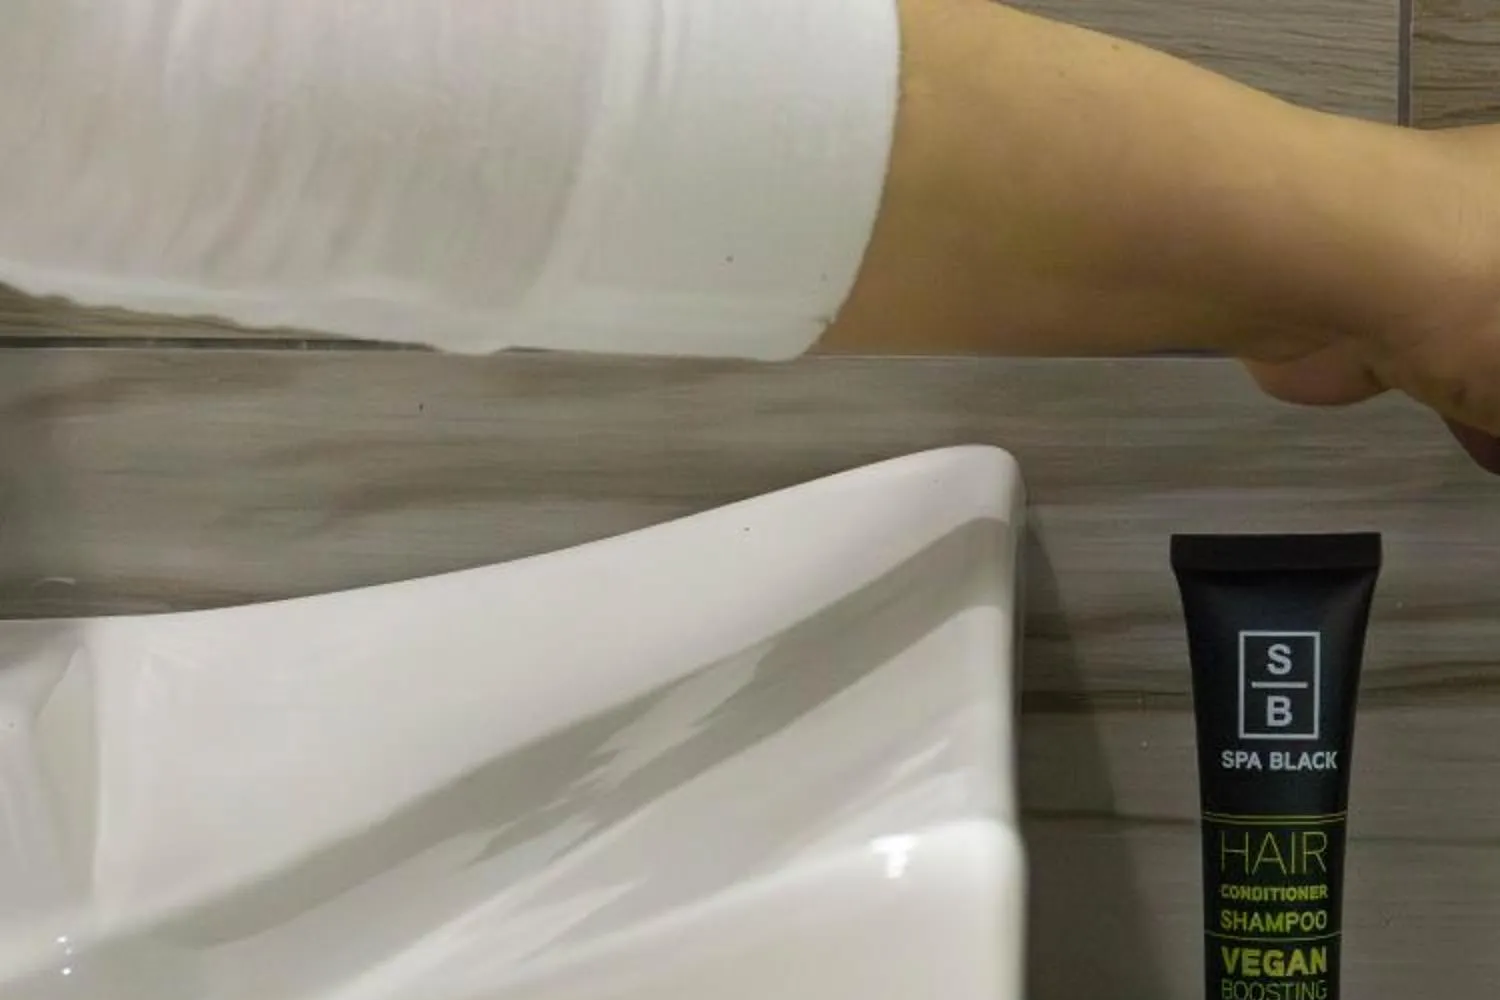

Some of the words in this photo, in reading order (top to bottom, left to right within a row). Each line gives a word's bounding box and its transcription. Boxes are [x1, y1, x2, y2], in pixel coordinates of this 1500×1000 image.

[1267, 643, 1293, 675] S
[1266, 695, 1292, 727] B
[1221, 750, 1262, 770] SPA
[1269, 752, 1338, 770] BLACK
[1220, 831, 1328, 875] HAIR
[1219, 884, 1328, 901] CONDITIONER
[1220, 909, 1328, 933] SHAMPOO
[1221, 946, 1327, 977] VEGAN
